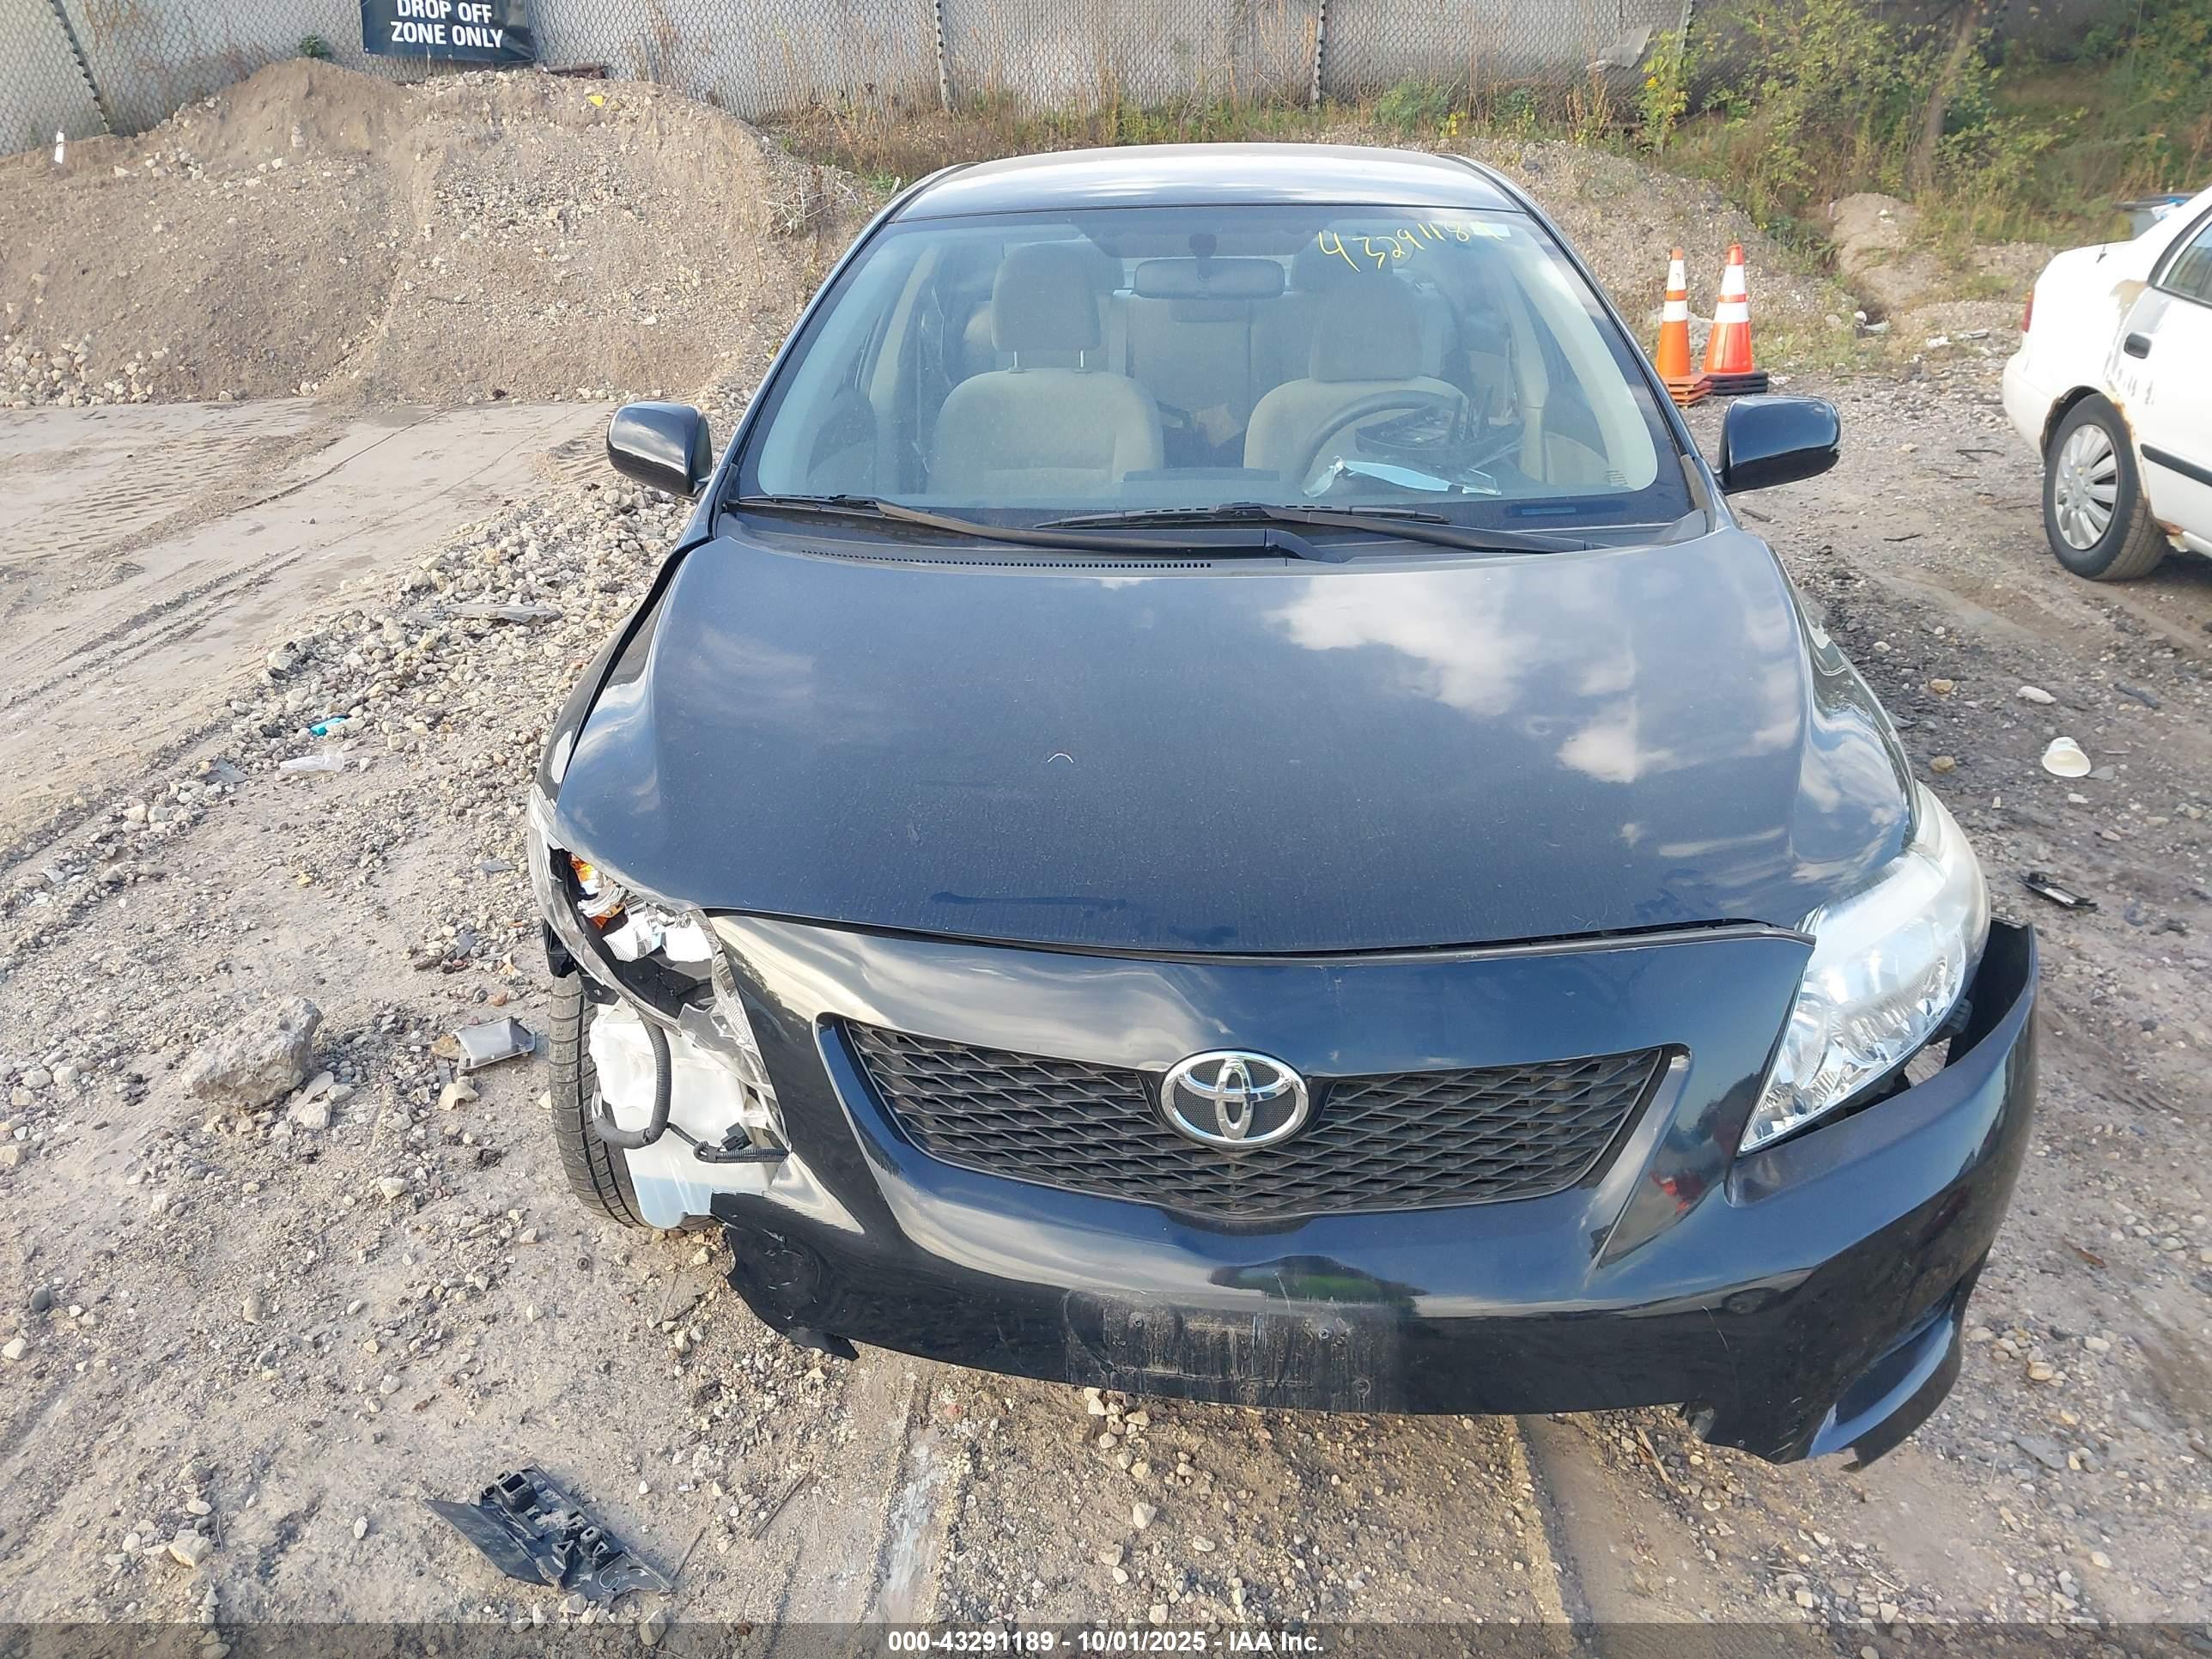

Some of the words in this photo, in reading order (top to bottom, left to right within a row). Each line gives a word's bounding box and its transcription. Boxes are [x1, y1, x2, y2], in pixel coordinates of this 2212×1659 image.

[398, 0, 452, 20] DROP
[458, 3, 493, 24] OFF
[390, 21, 447, 45] ZONE
[452, 25, 503, 48] ONLY
[1318, 221, 1504, 273] 4329118
